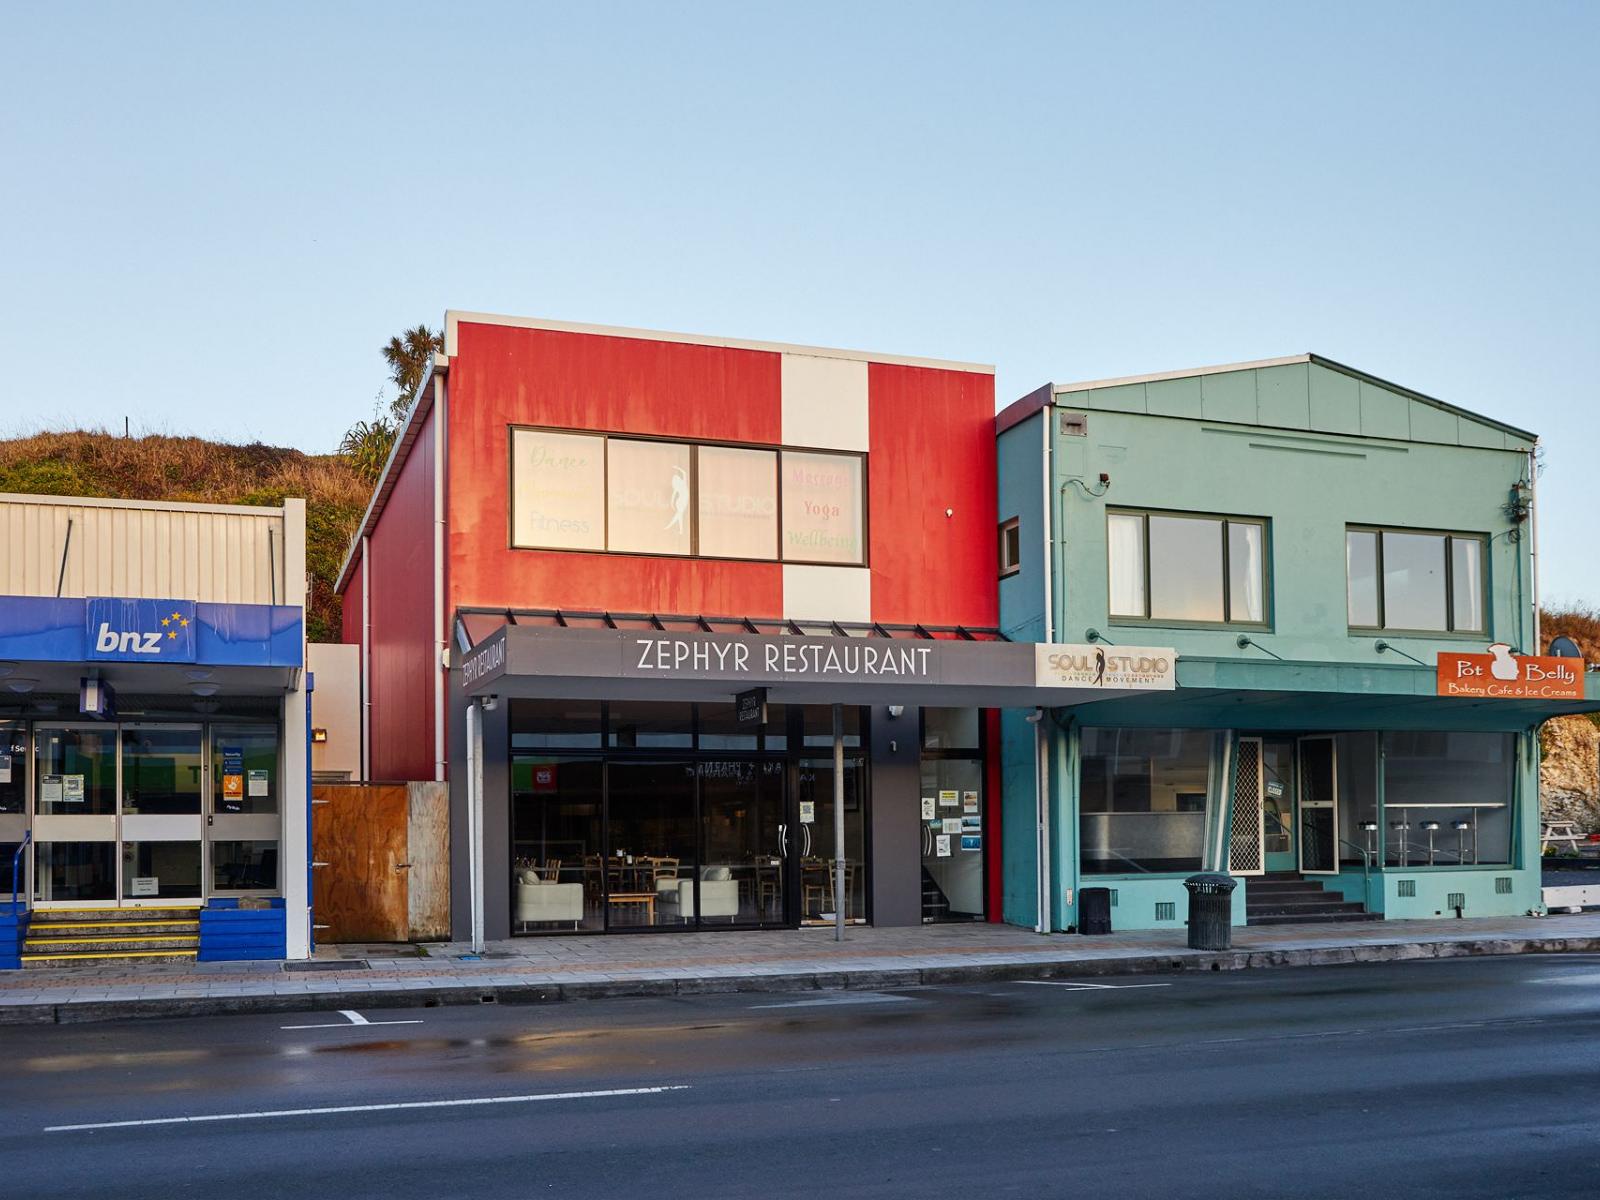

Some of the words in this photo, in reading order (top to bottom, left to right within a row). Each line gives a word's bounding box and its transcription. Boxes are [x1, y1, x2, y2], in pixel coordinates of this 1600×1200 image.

[804, 500, 841, 521] Yoga
[95, 622, 163, 653] bnz
[636, 639, 750, 672] ZEPHYR
[765, 643, 932, 676] RESTAURANT
[1048, 654, 1093, 672] SOUL
[1107, 656, 1169, 674] STUDIO
[1457, 660, 1484, 678] Pot
[1525, 663, 1576, 685] Belly
[1448, 682, 1486, 696] Bakery
[1487, 684, 1513, 696] Cafe
[1525, 686, 1539, 696] Ice
[1540, 686, 1577, 697] Creams
